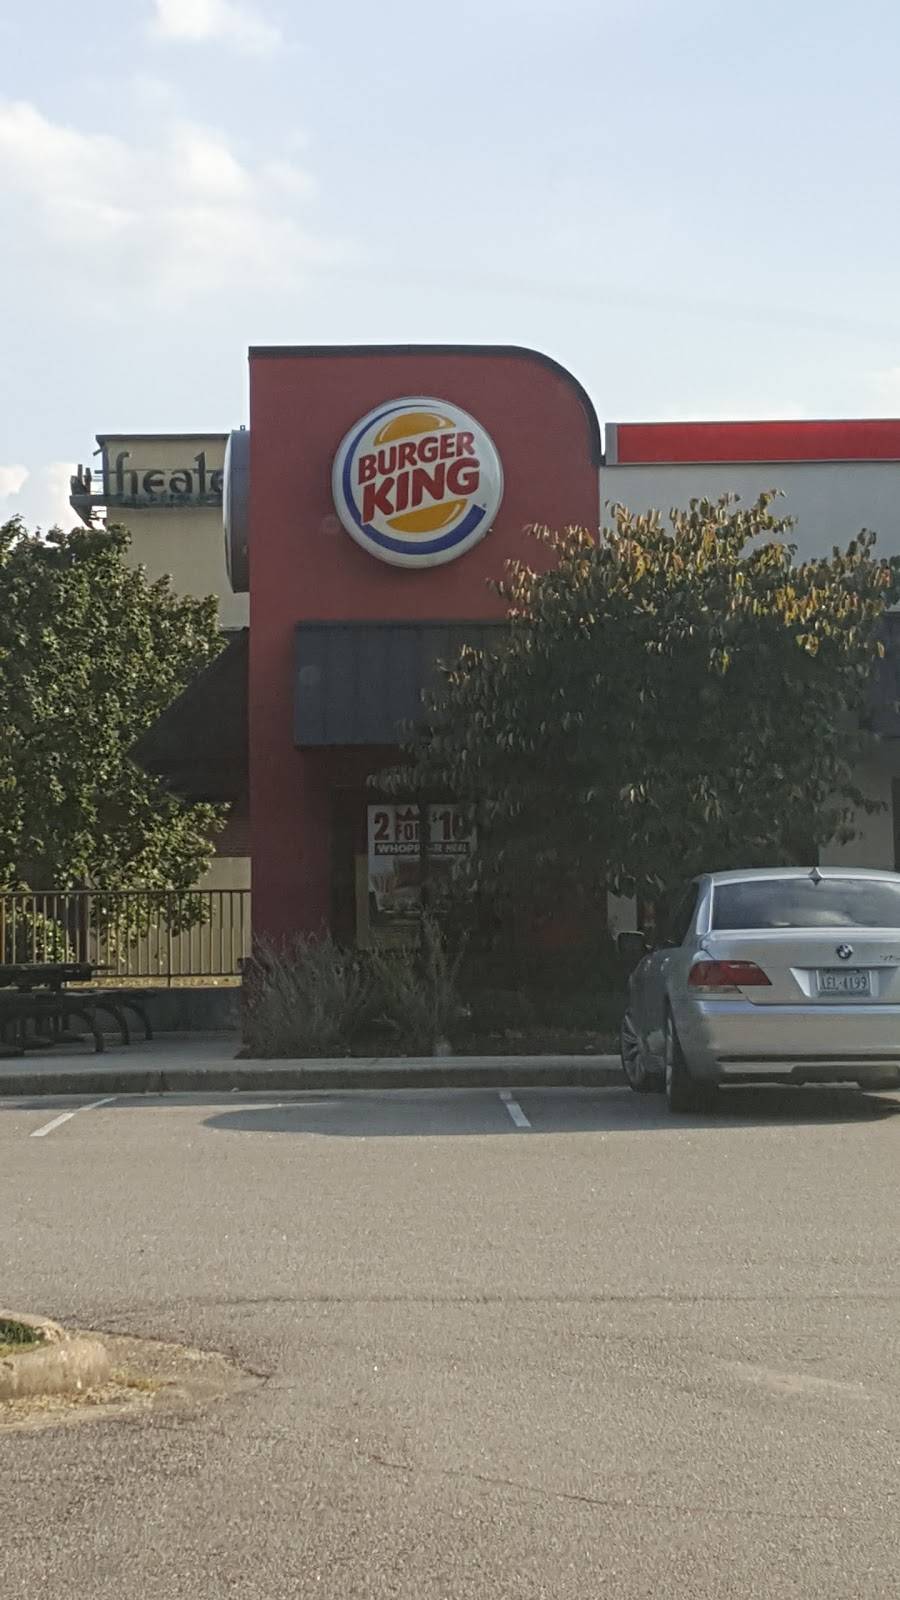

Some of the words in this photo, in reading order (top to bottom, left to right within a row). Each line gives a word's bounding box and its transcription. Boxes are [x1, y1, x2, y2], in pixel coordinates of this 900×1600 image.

[358, 431, 475, 485] BURGER
[361, 458, 480, 524] KING
[374, 811, 390, 841] 2
